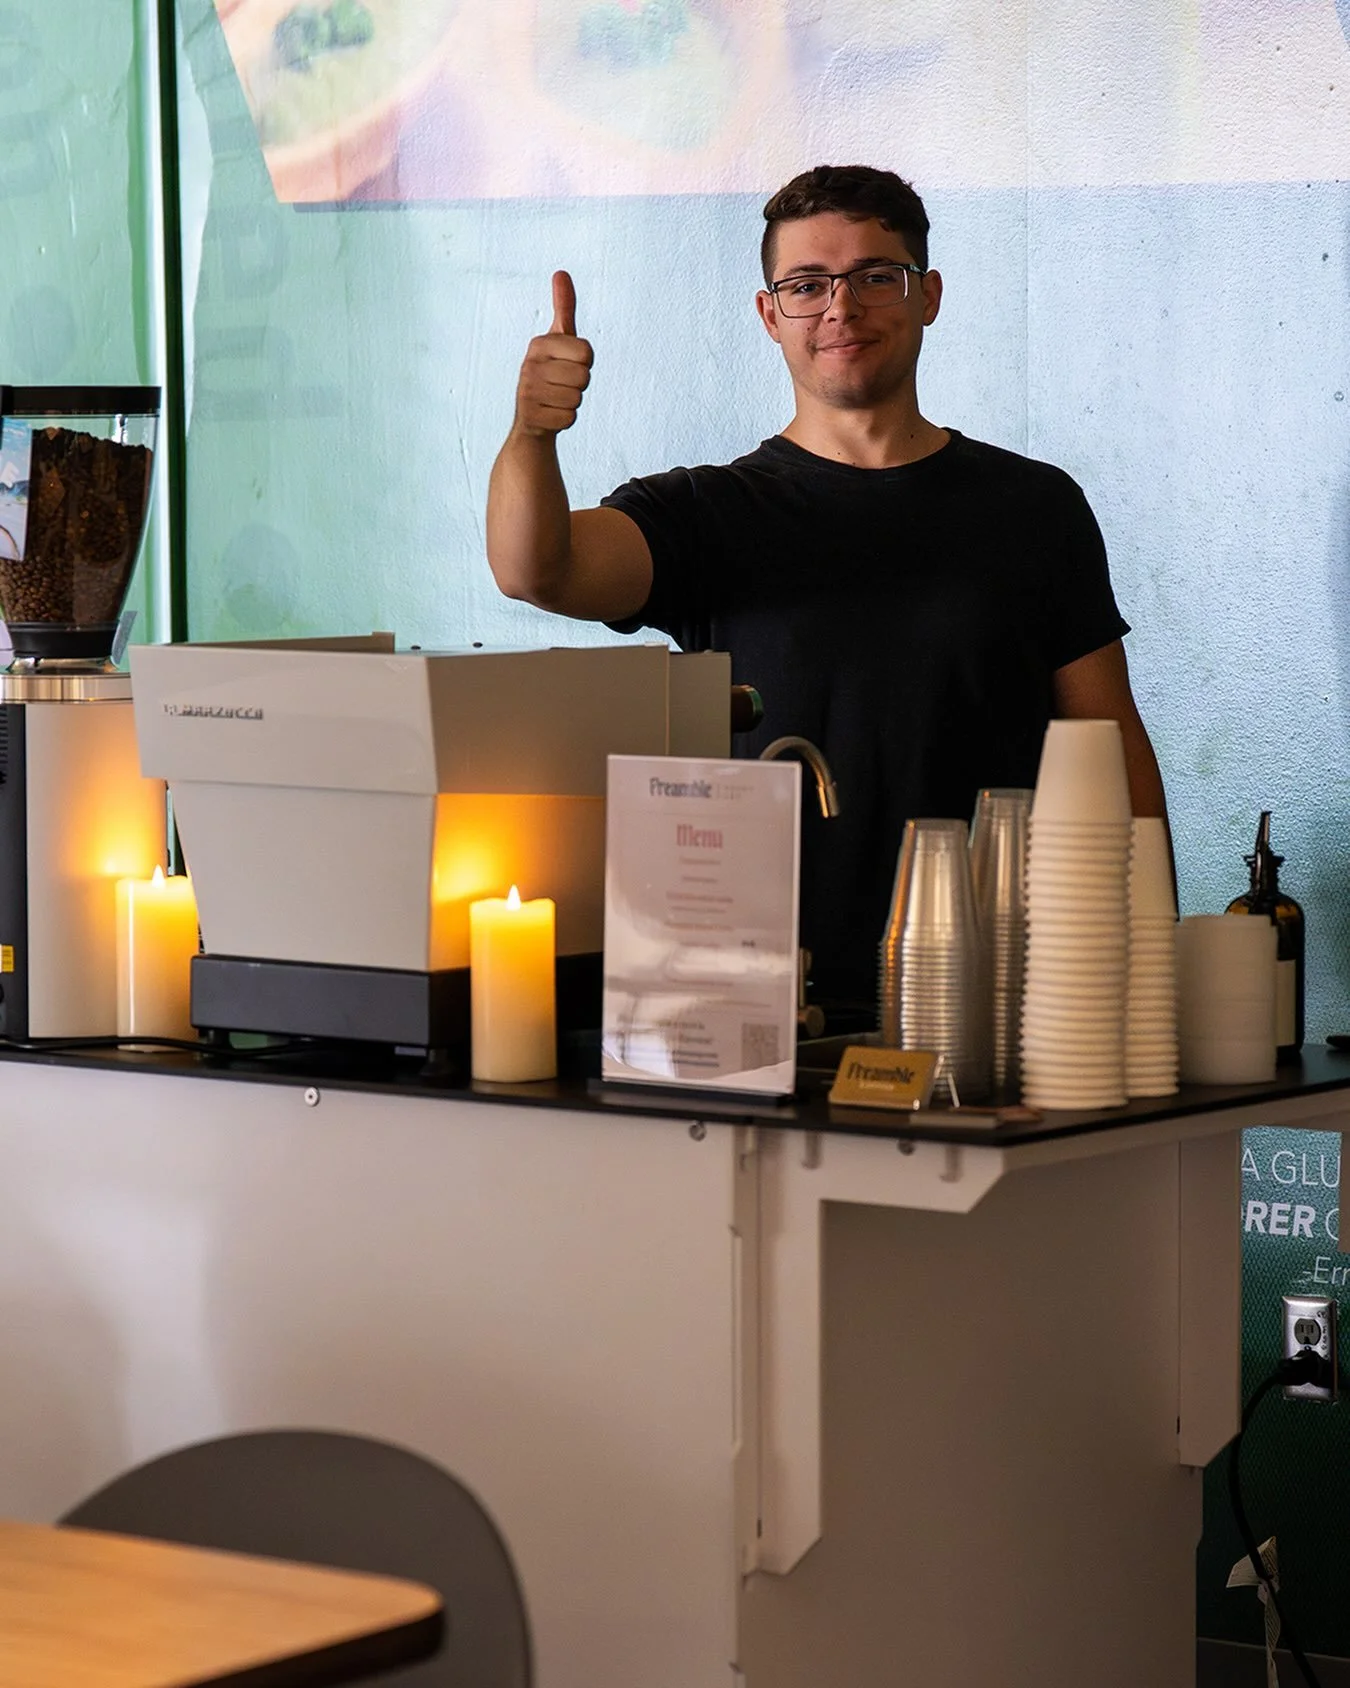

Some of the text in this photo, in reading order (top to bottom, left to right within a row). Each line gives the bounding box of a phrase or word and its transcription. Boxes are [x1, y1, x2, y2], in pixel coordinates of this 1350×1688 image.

[649, 777, 713, 799] Preamble
[676, 823, 724, 849] Menu
[1271, 1150, 1341, 1188] GLU
